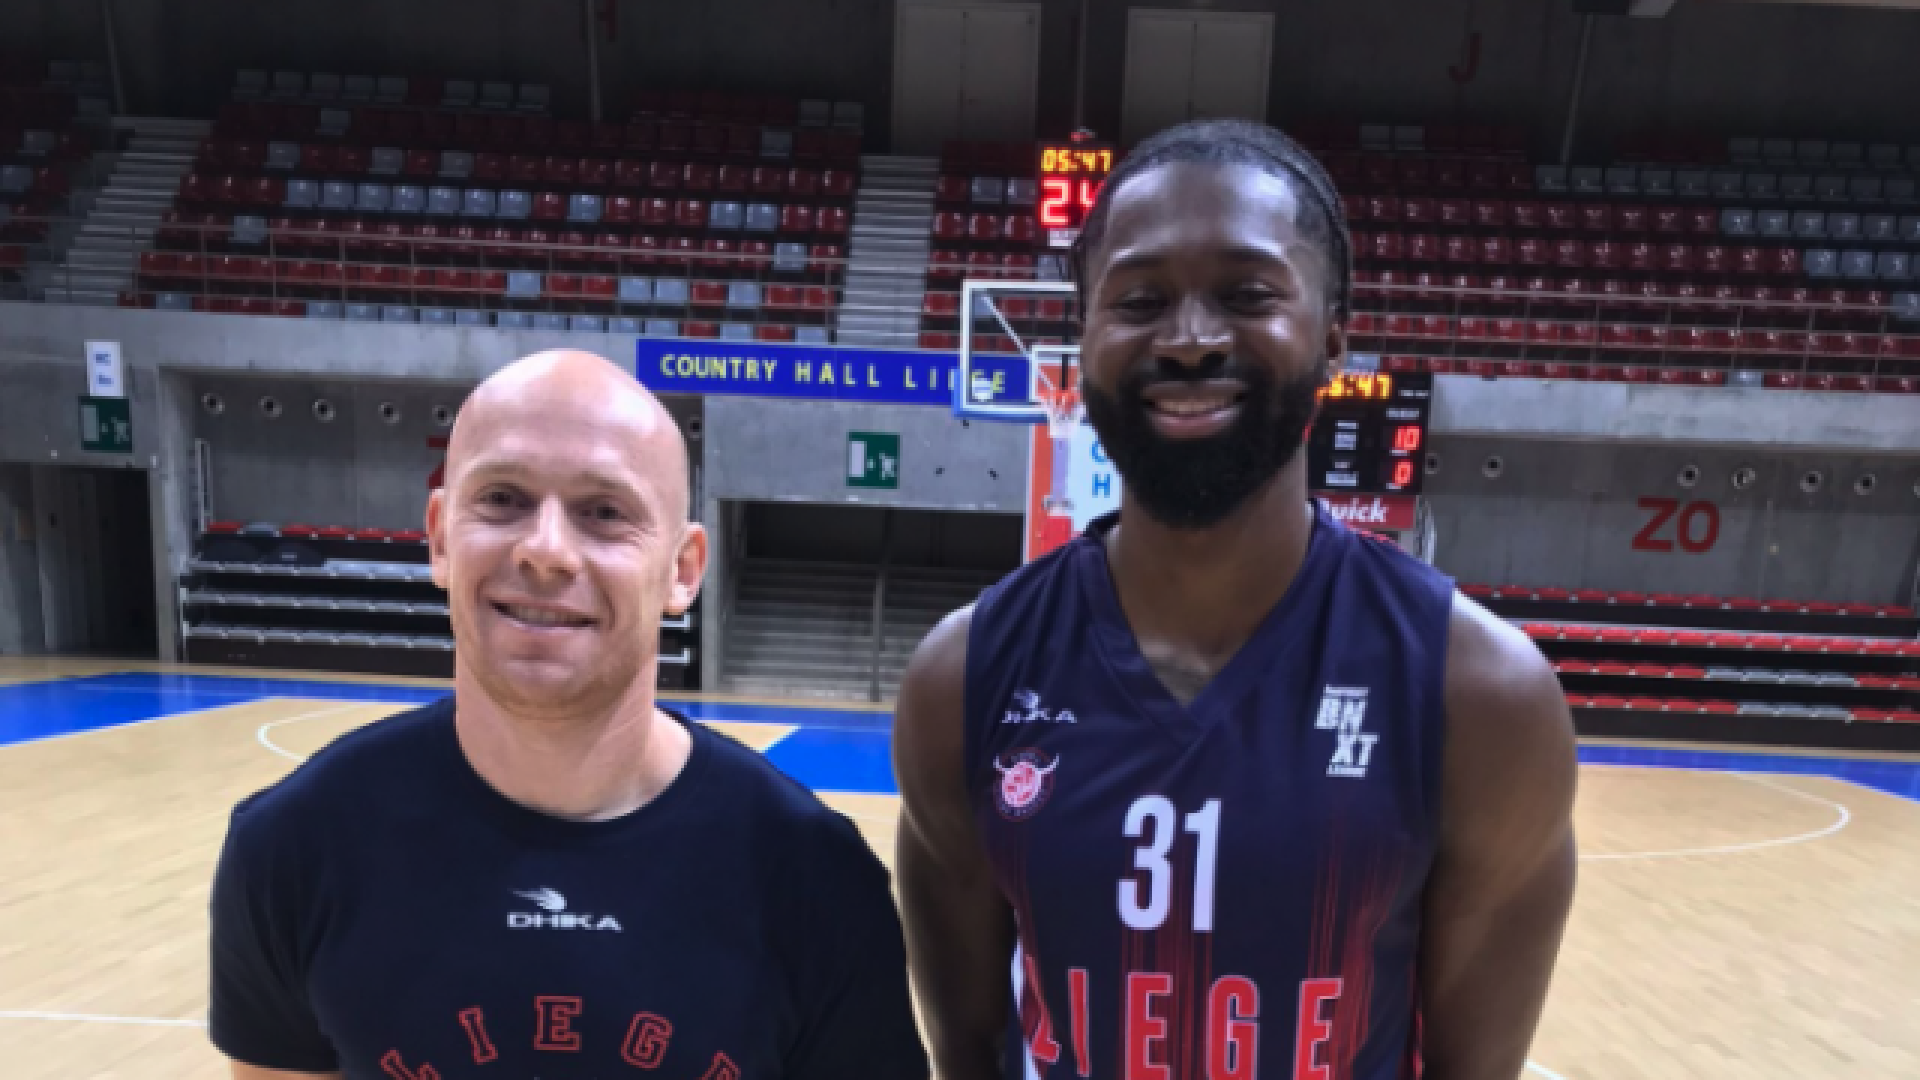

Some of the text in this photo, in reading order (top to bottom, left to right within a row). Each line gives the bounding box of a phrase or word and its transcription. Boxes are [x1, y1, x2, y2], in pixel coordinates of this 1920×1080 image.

[659, 353, 777, 382] COUNTRY
[794, 359, 879, 387] HALL
[1395, 426, 1421, 450] 10
[1320, 497, 1388, 522] uick
[1117, 795, 1222, 932] 31
[507, 912, 623, 932] DHIKA
